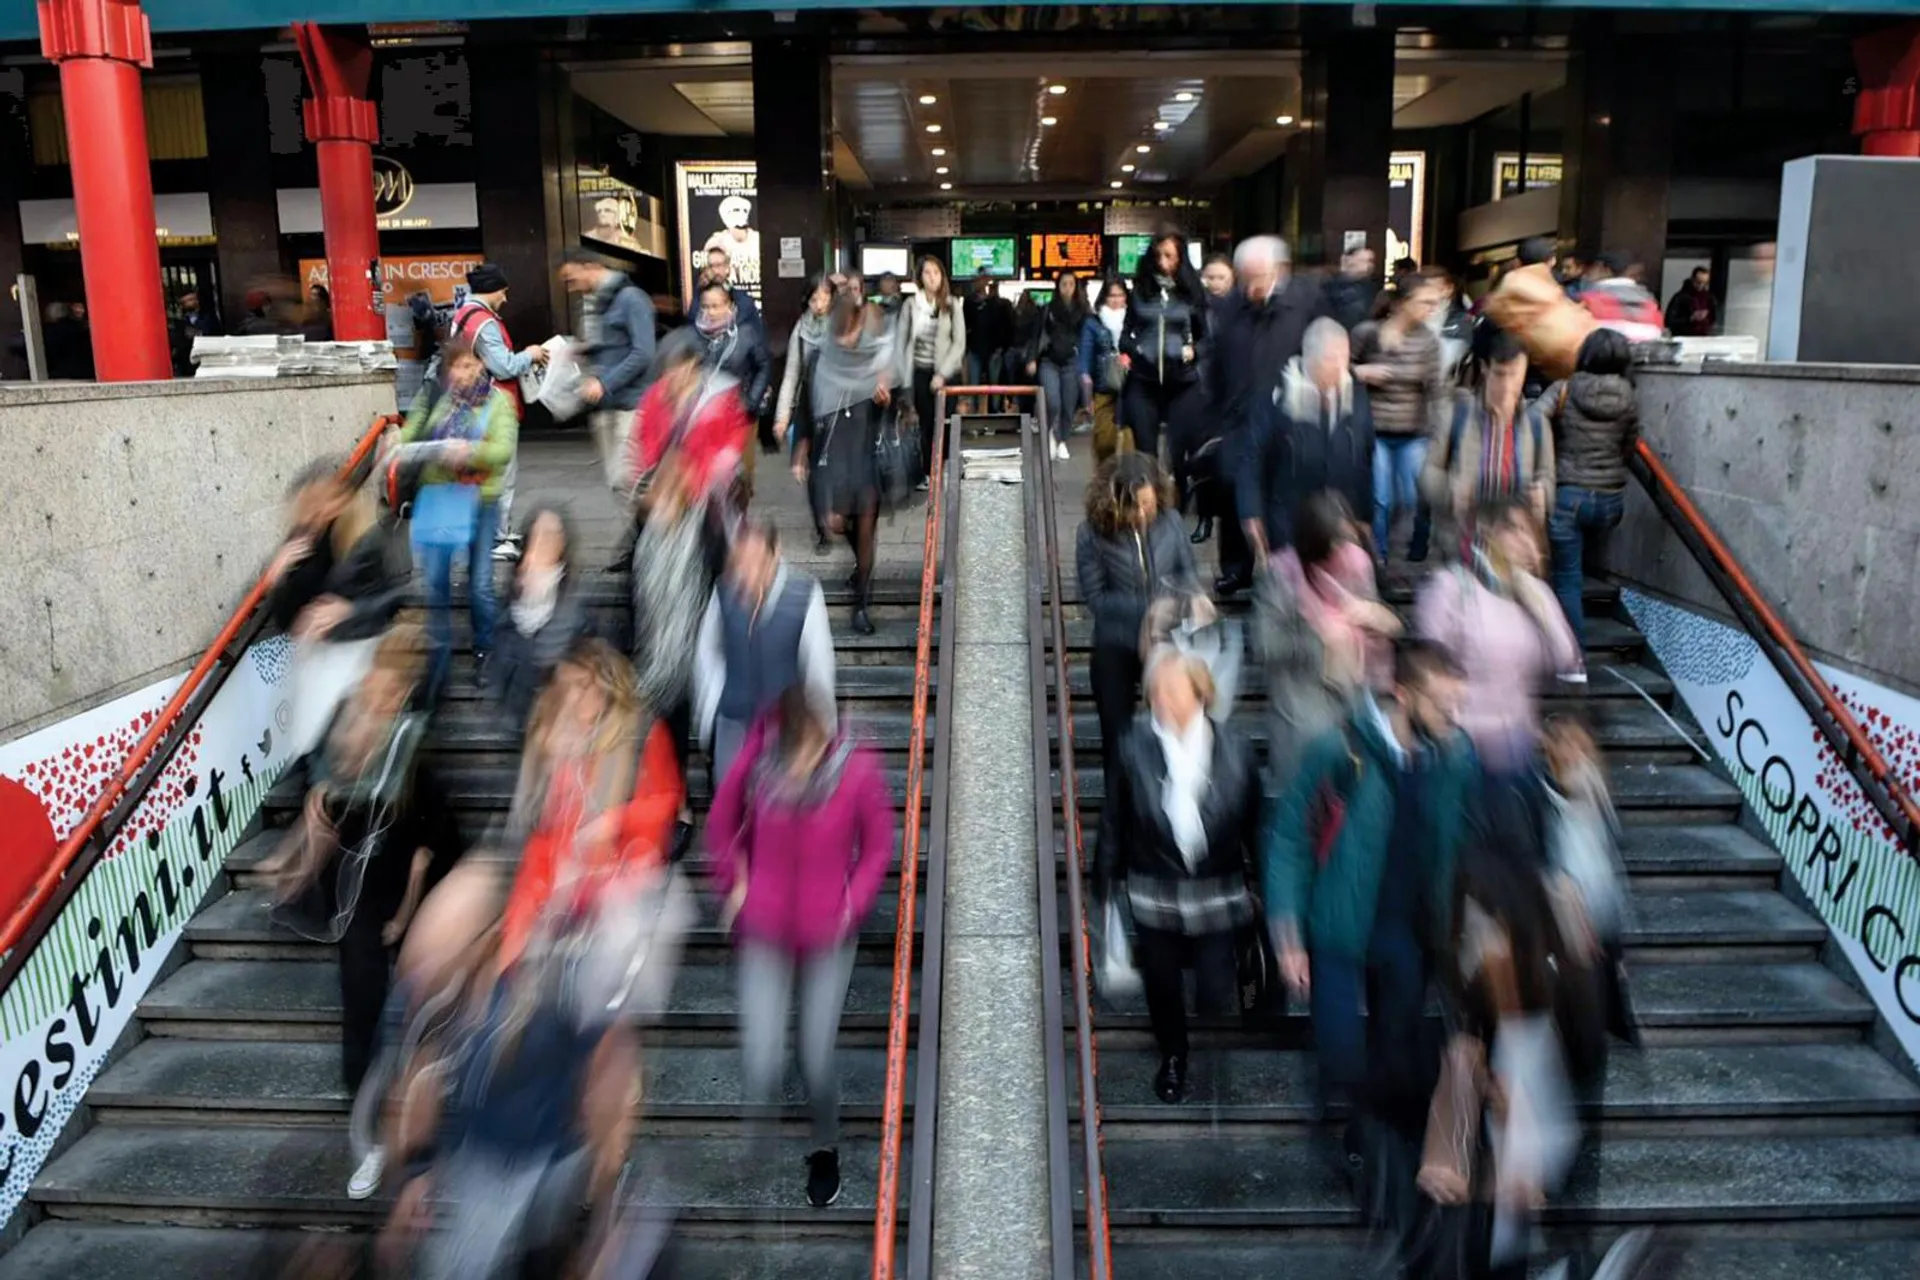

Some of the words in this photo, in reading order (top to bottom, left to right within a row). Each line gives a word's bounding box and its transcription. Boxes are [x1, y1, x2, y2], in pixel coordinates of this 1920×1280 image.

[688, 173, 745, 189] HALLOWEEN
[384, 263, 404, 280] IN
[407, 261, 483, 280] CRESCIT
[1716, 690, 1859, 906] SCOPRI
